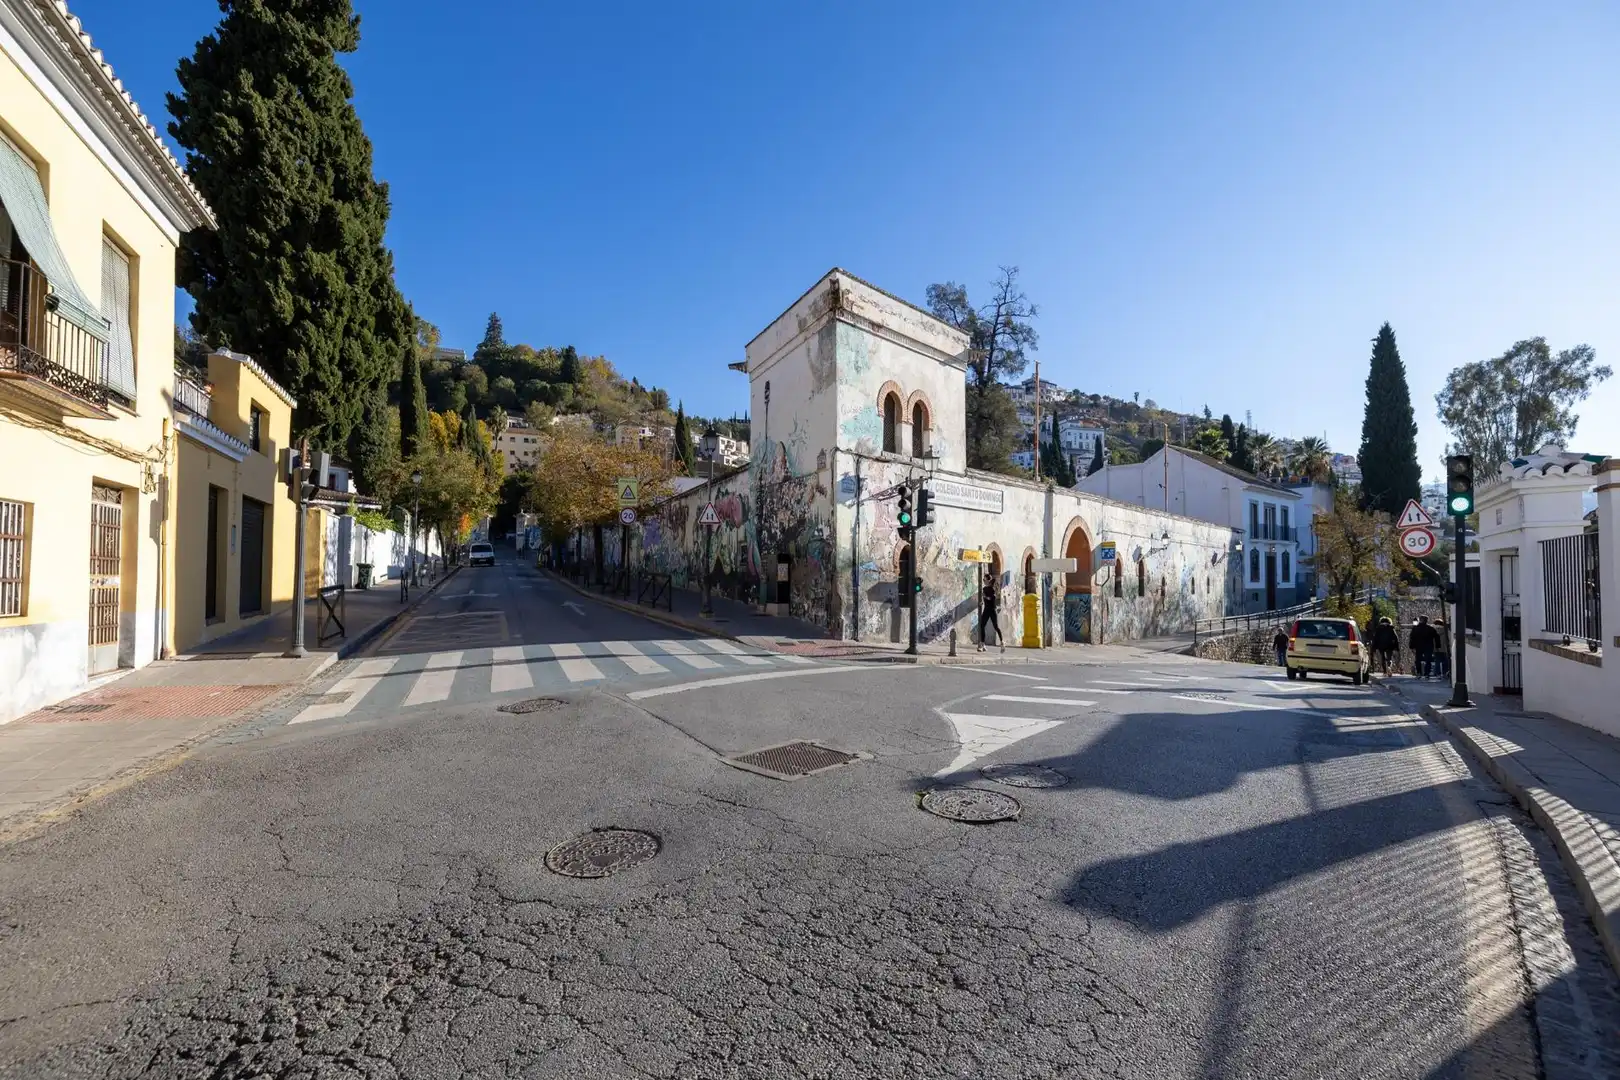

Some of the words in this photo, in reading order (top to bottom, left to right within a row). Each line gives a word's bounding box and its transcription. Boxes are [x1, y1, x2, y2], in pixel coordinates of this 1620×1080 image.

[935, 482, 960, 496] COLEGIO
[961, 486, 978, 499] SANTO
[979, 489, 1002, 503] DOMINGO
[623, 512, 633, 520] 20
[1408, 536, 1428, 547] 30
